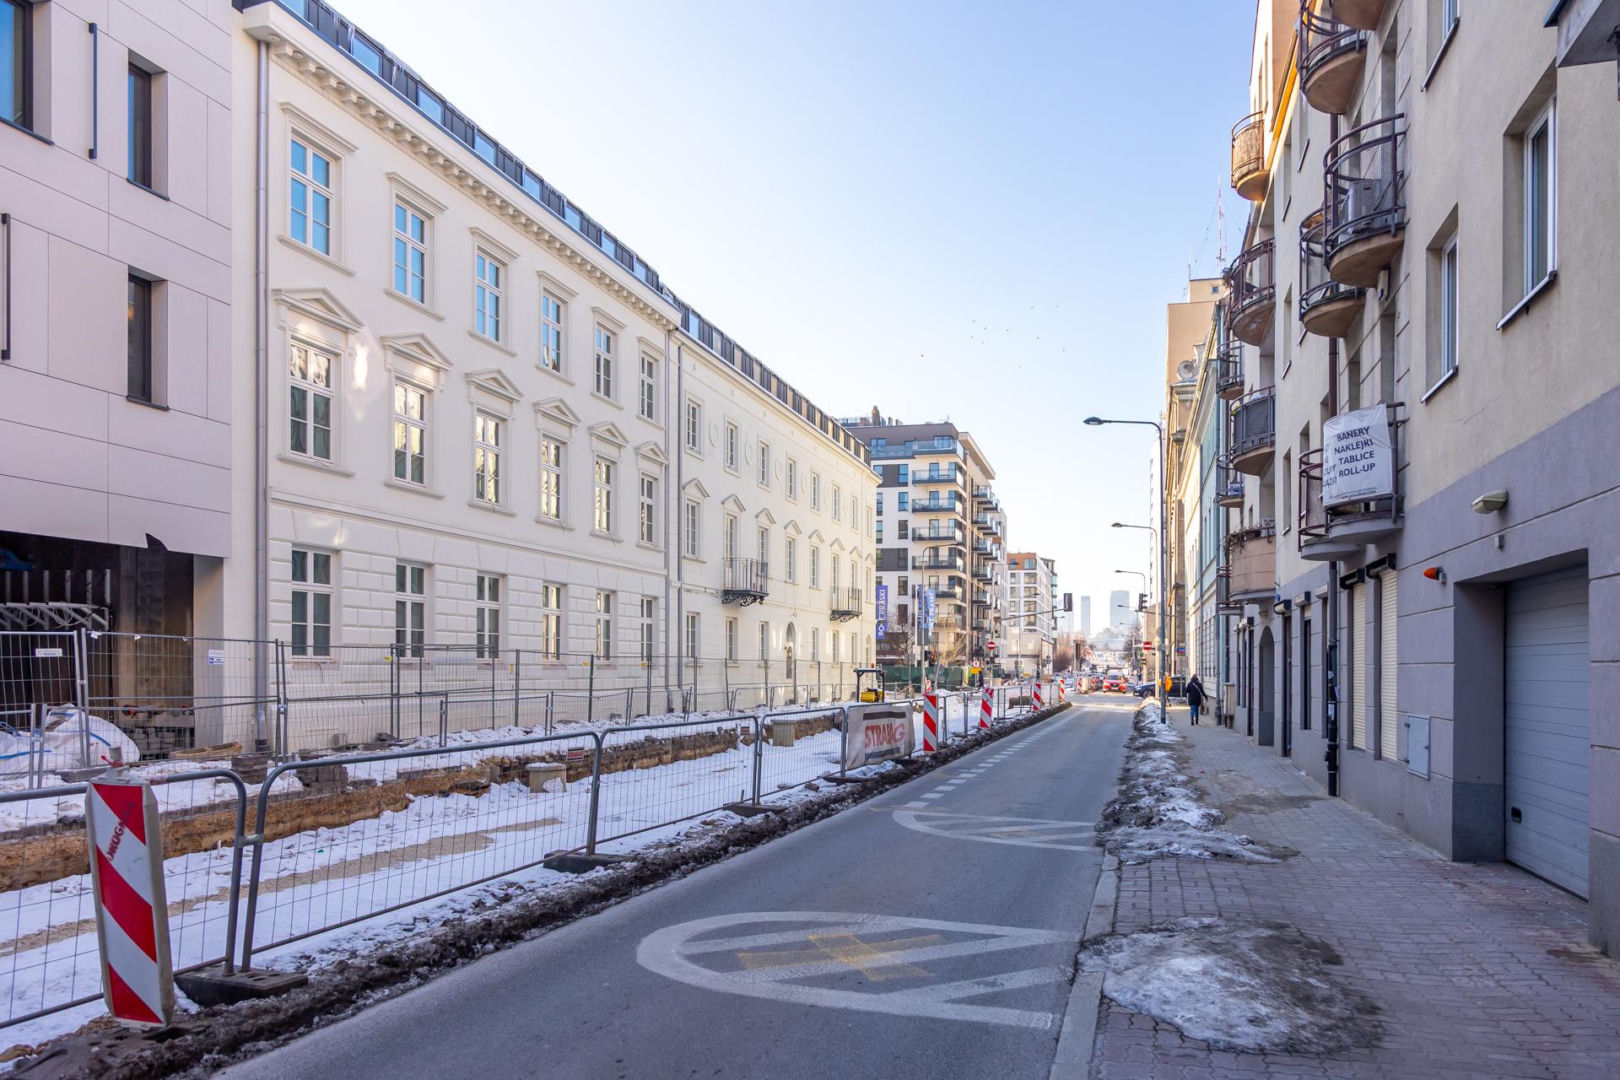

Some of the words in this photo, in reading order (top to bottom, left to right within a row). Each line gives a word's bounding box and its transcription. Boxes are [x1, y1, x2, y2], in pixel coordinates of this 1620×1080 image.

[1337, 426, 1370, 441] BANERY
[1334, 438, 1374, 455] NAKLEJKI
[1339, 450, 1375, 465] TABLICE
[1338, 462, 1376, 478] ROLL-UP
